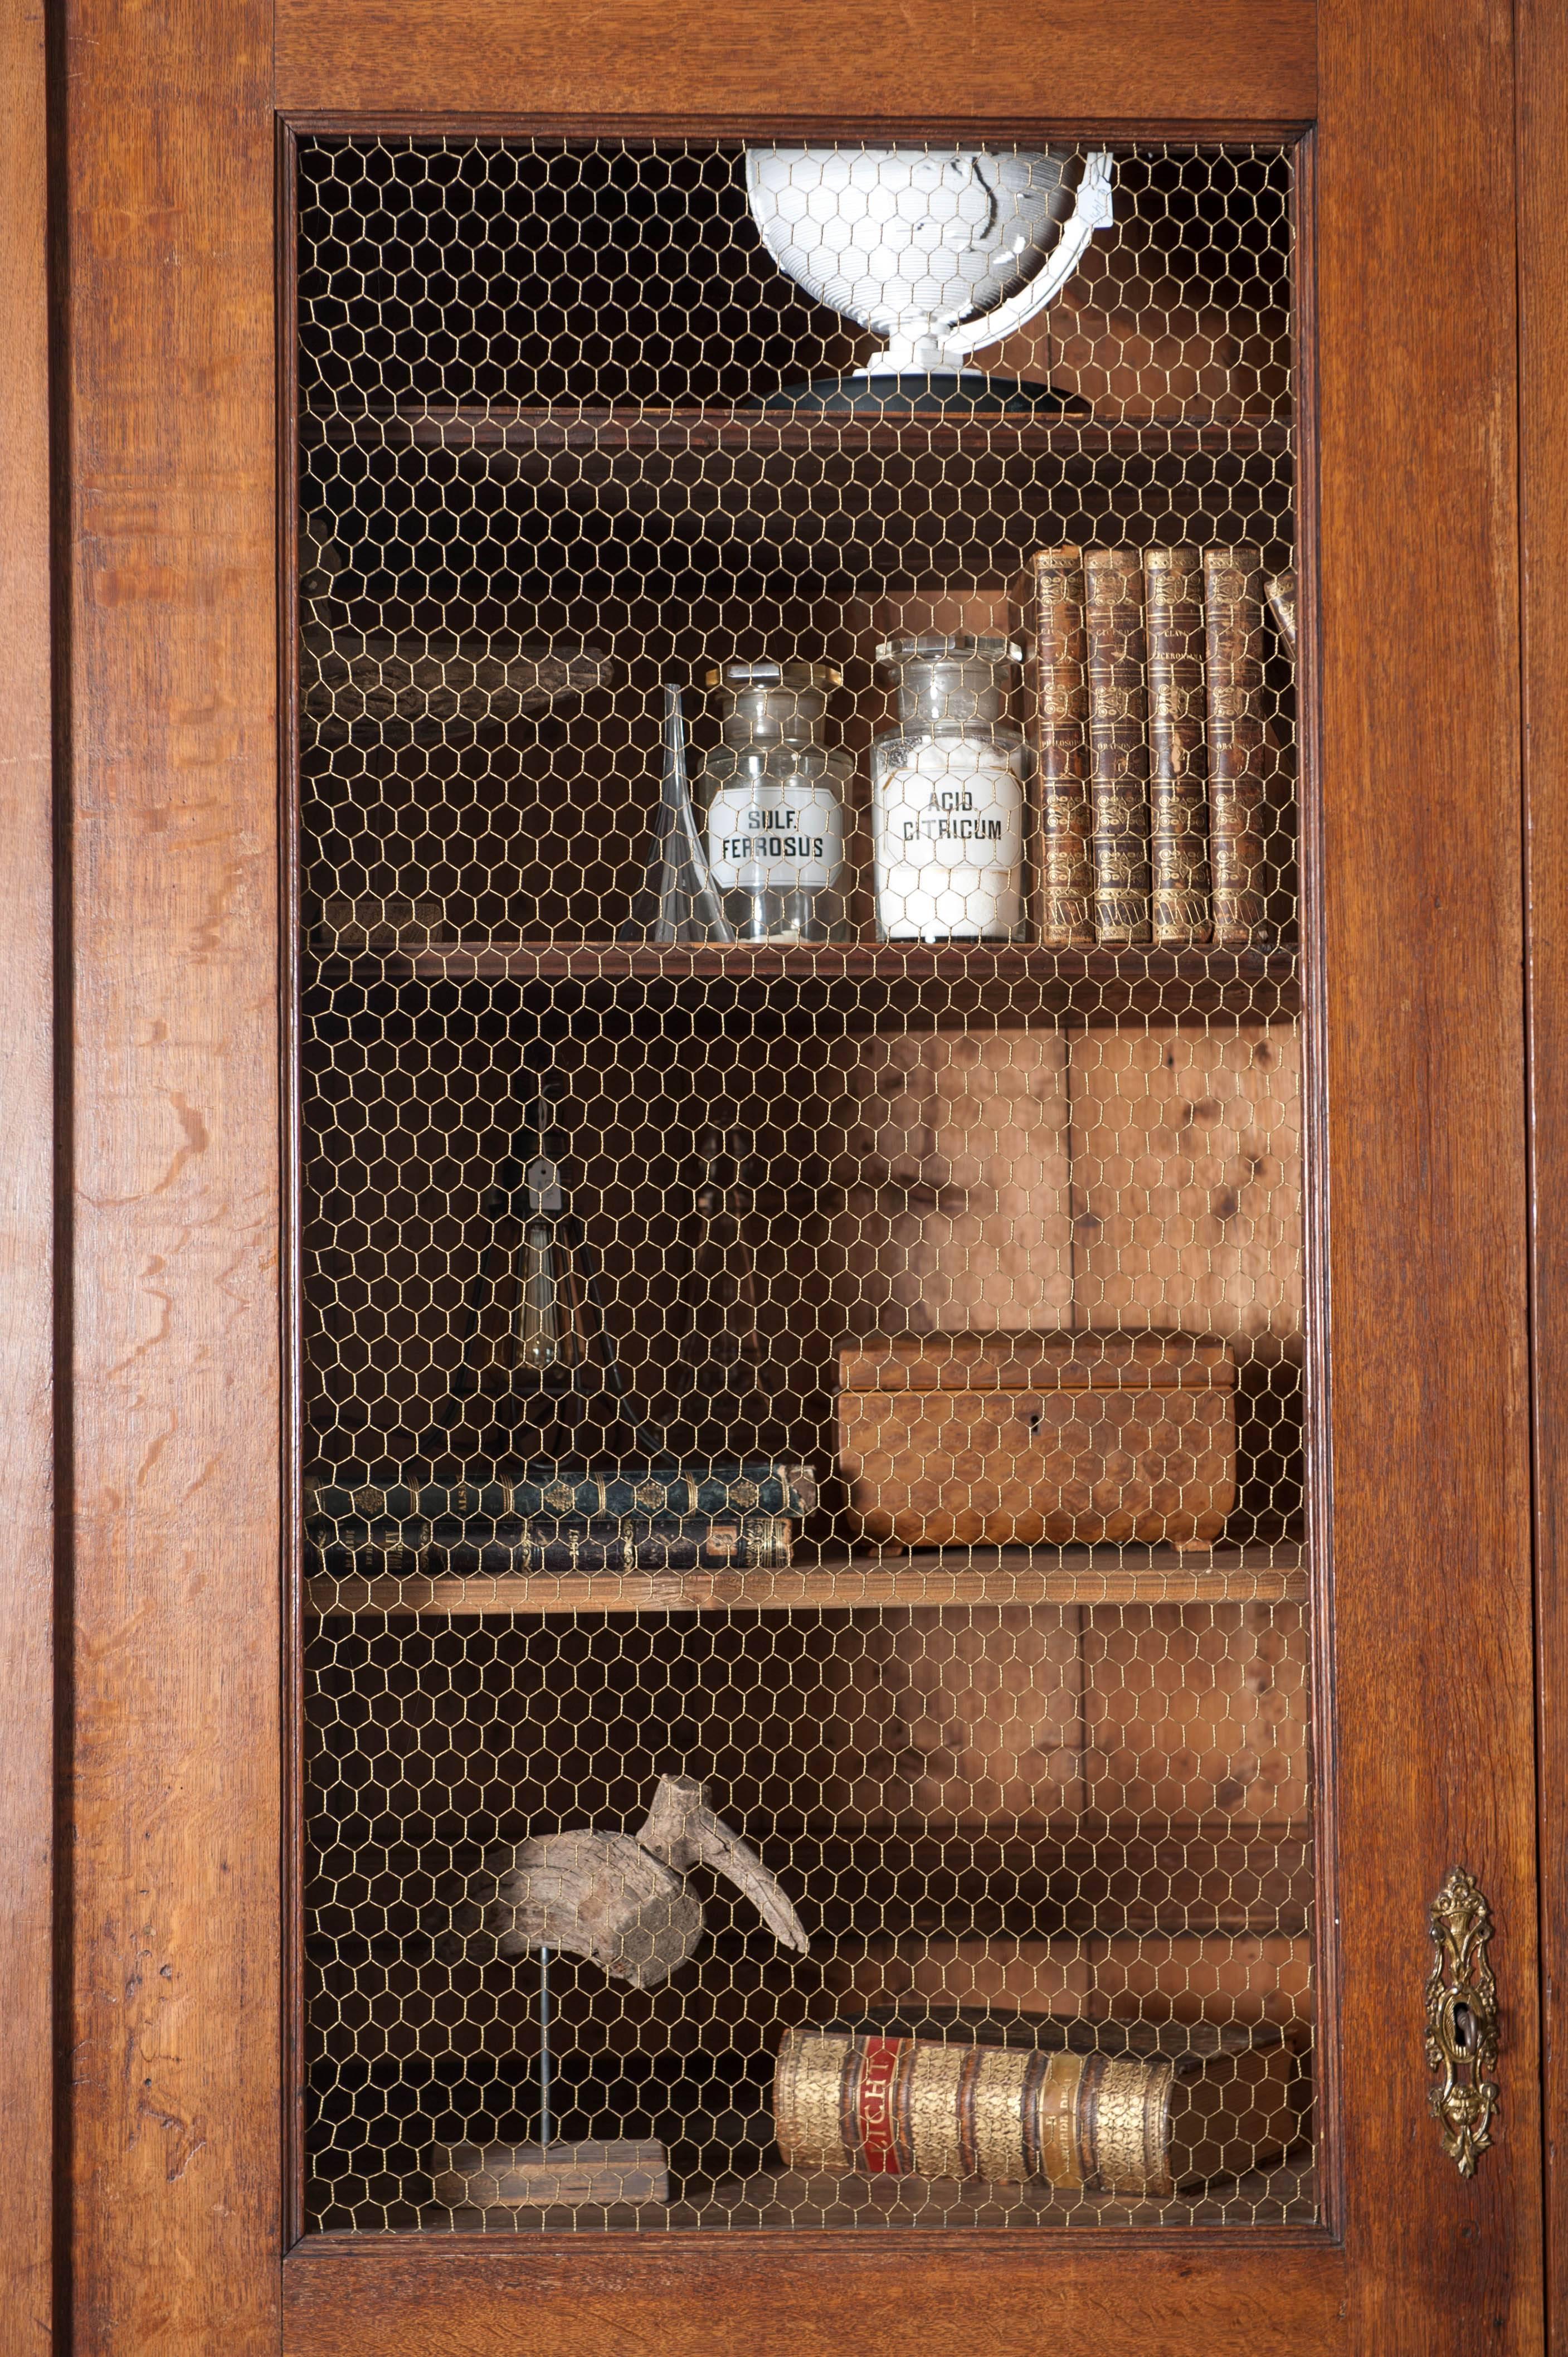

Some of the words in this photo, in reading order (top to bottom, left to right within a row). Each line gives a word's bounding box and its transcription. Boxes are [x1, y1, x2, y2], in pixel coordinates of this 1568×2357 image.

[928, 792, 972, 811] ACID
[748, 810, 797, 829] SULF.
[903, 819, 1001, 840] CITRICUM
[723, 837, 822, 858] FERROSUS
